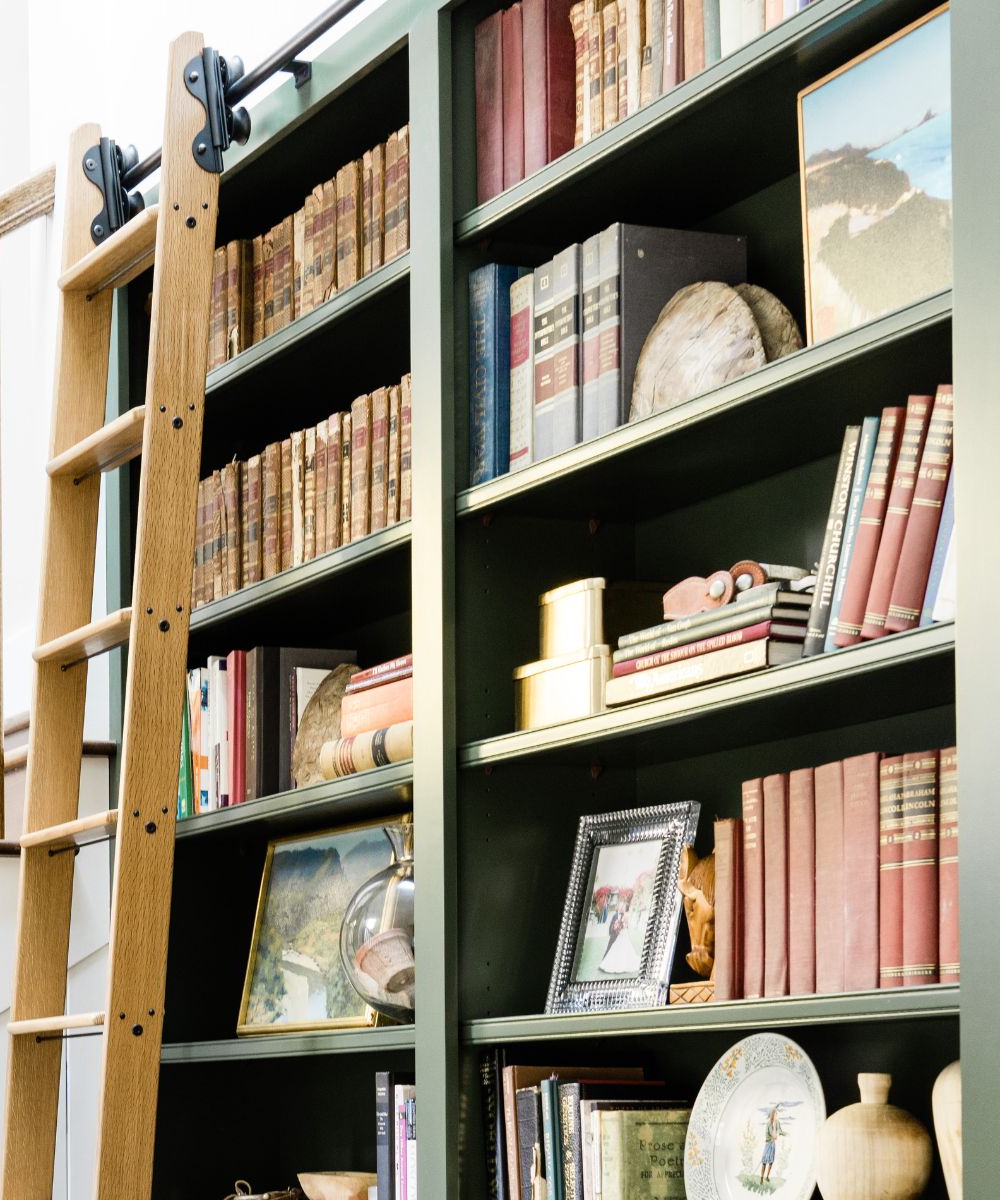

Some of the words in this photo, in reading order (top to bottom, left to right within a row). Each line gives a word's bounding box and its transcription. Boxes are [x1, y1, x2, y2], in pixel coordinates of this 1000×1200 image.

[837, 443, 857, 515] WINSTON
[820, 520, 844, 608] CHURCHILL
[635, 659, 653, 670] CHURCH
[654, 657, 661, 665] OF
[661, 654, 670, 663] THE
[689, 648, 696, 656] ON
[696, 644, 705, 653] THE
[707, 638, 725, 650] SPILLED
[726, 631, 743, 644] BLOOD
[904, 800, 936, 811] LINCOLN
[640, 1139, 674, 1151] Prose
[651, 1154, 684, 1167] Poetr
